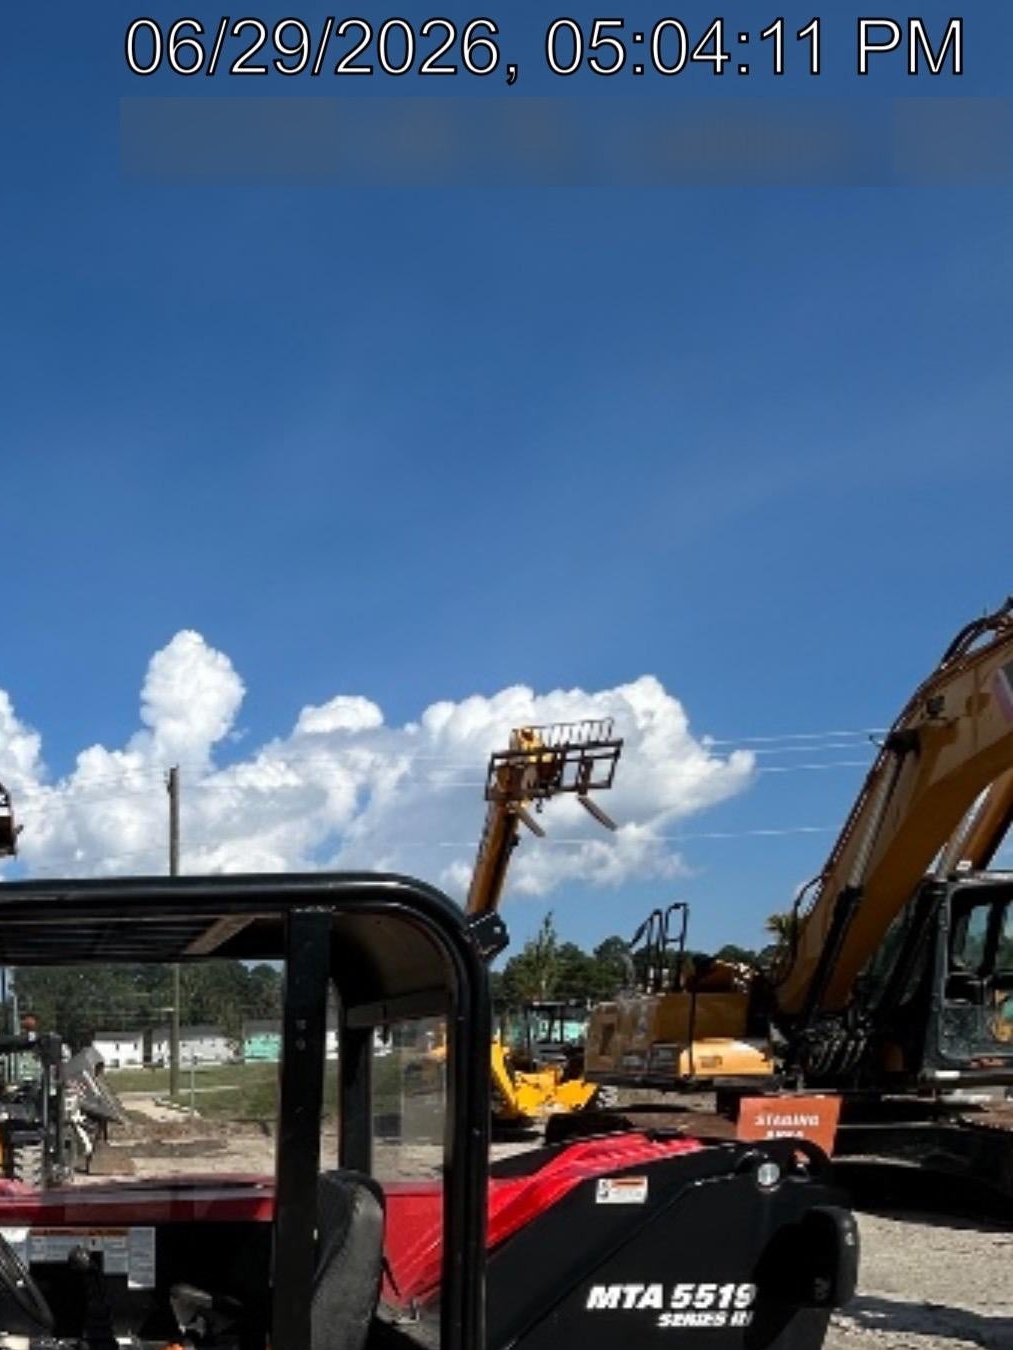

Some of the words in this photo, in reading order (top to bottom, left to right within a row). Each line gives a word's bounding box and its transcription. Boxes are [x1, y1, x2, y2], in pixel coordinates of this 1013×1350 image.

[586, 1283, 663, 1309] MTA
[670, 1283, 756, 1309] 5519
[656, 1311, 727, 1327] SERIES
